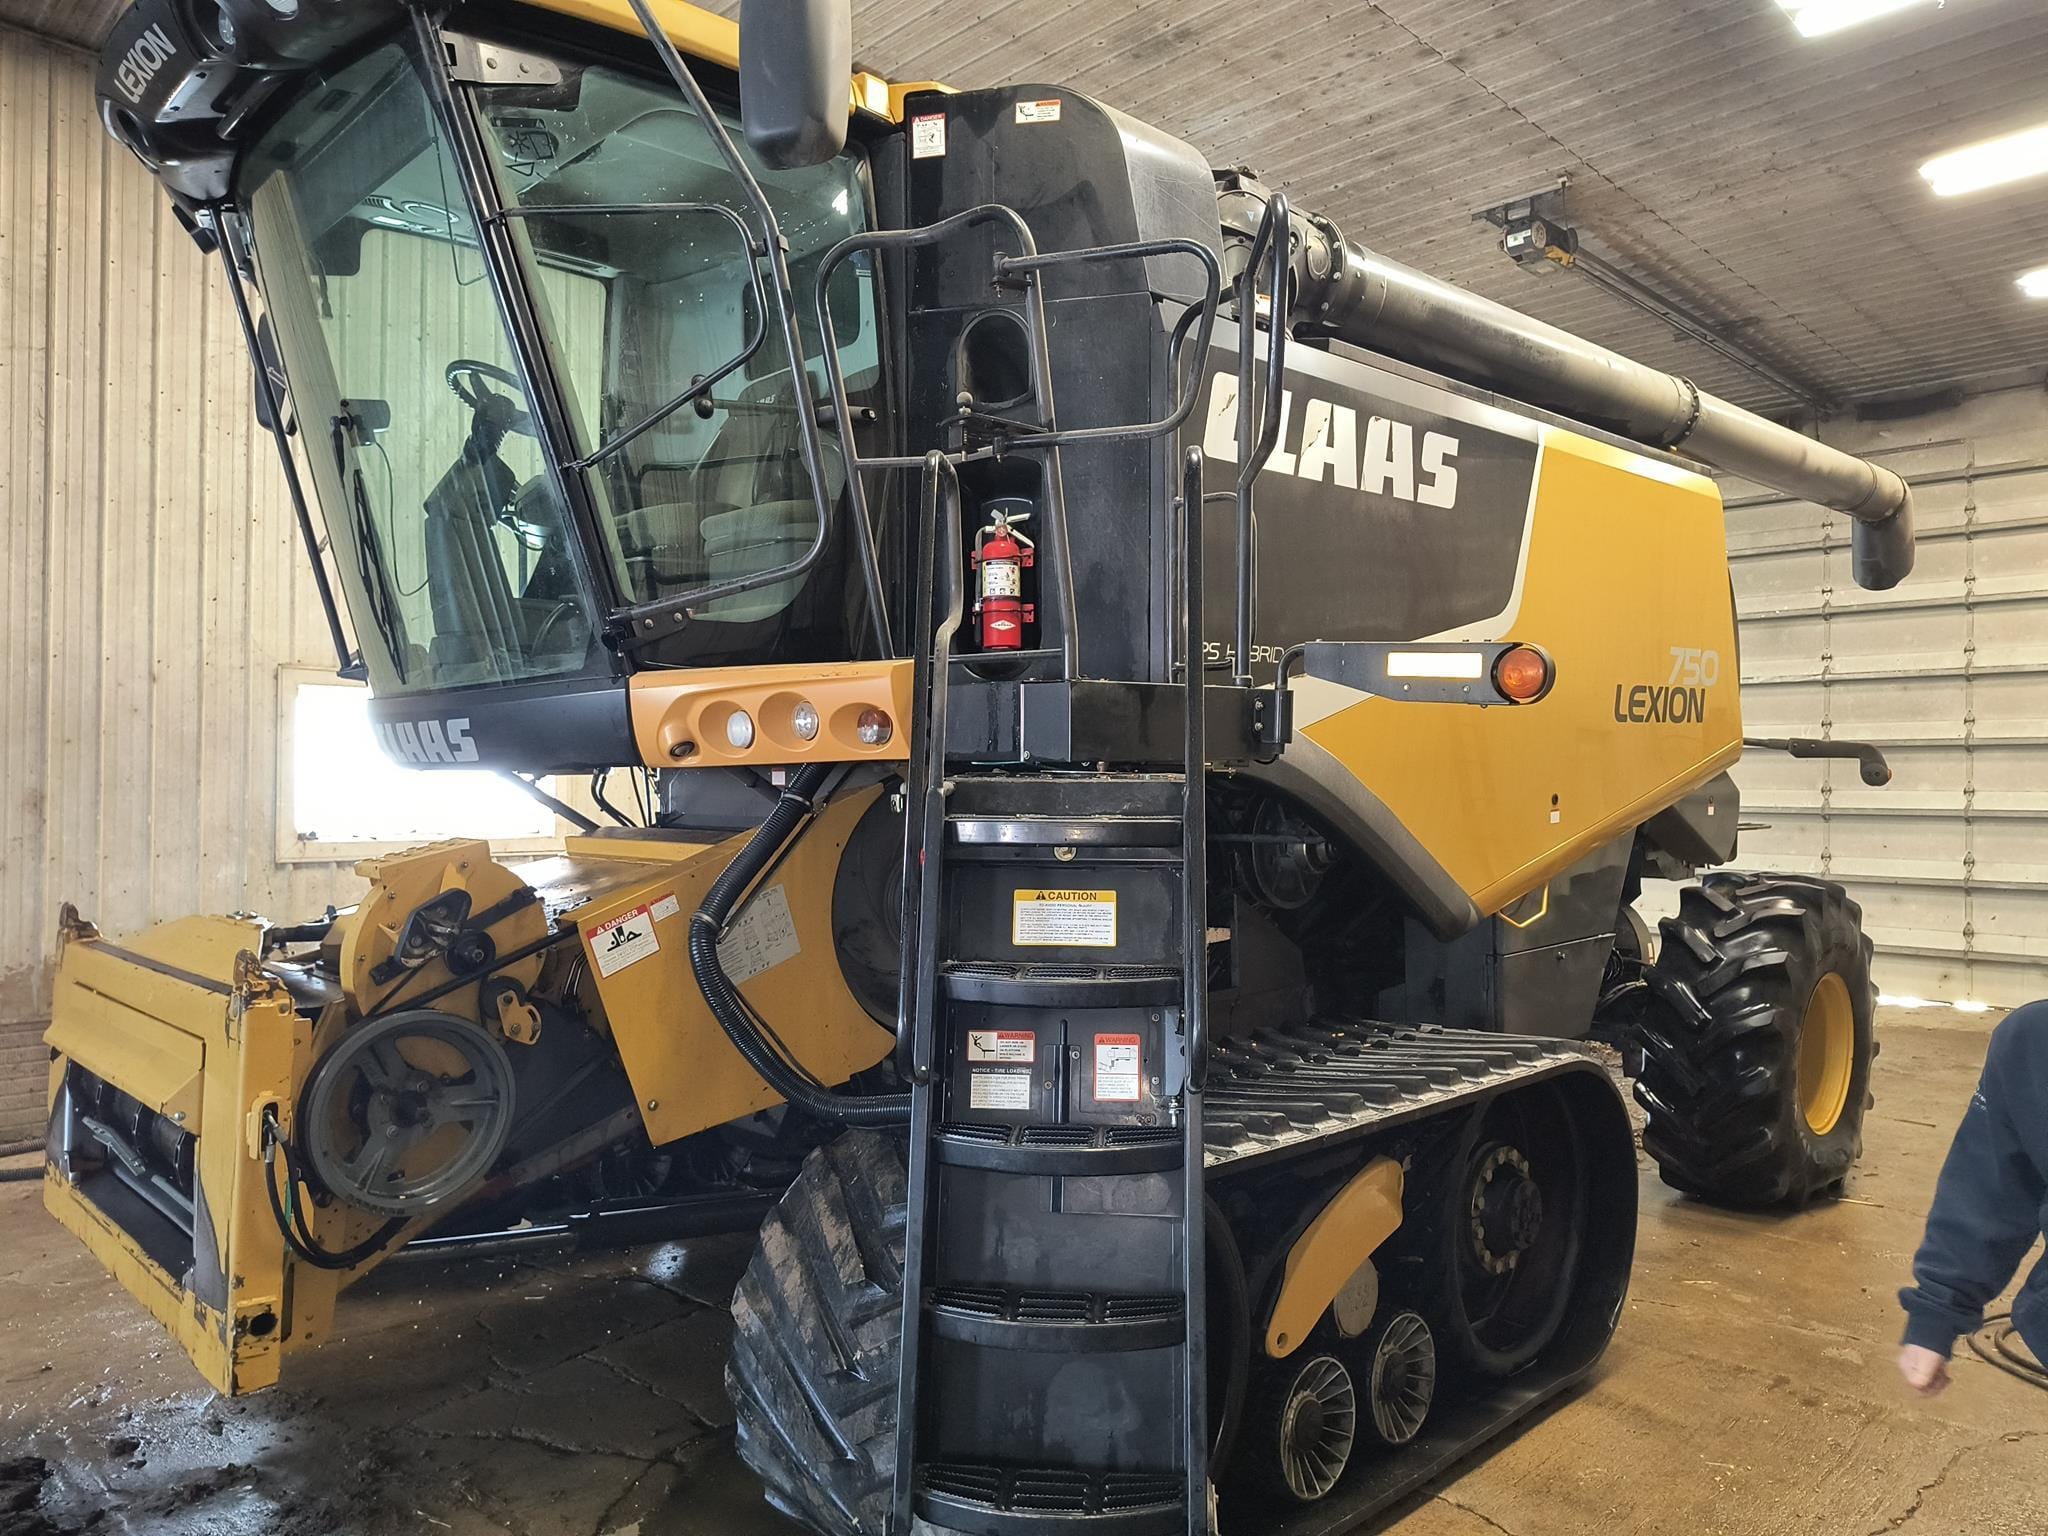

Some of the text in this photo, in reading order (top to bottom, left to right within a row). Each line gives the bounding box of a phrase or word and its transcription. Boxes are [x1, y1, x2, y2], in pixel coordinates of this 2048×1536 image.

[114, 22, 177, 104] LEXION
[1203, 641, 1285, 664] PS HBRID
[1668, 646, 1720, 687] 750
[1614, 684, 1706, 724] LEXION
[1047, 891, 1097, 901] CAUTION
[604, 909, 640, 930] DANGER
